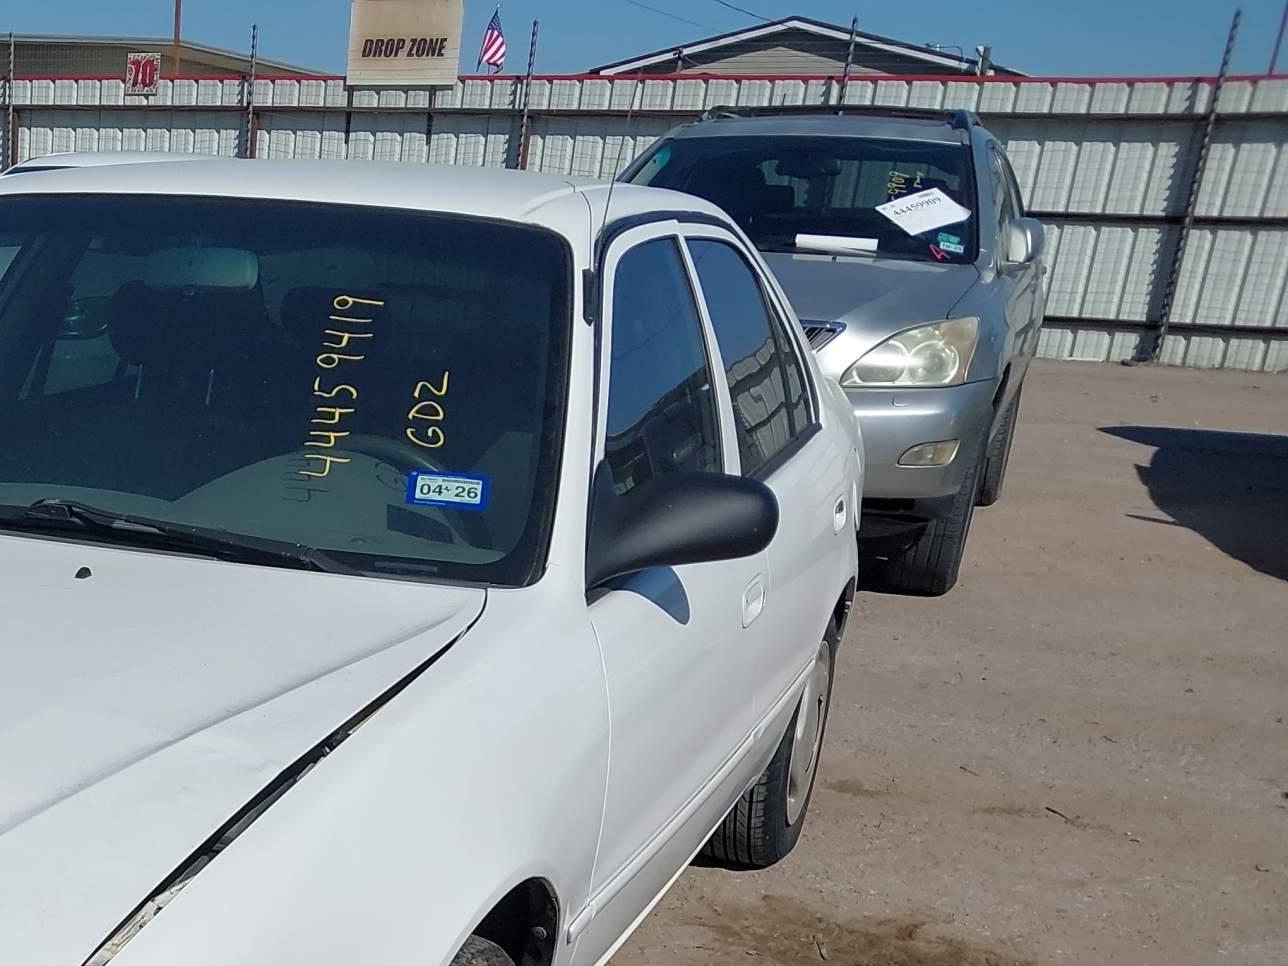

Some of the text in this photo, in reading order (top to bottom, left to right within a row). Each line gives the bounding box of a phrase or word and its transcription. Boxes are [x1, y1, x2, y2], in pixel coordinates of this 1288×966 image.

[361, 37, 448, 58] DROP ZONE
[131, 58, 155, 87] 70
[888, 170, 910, 200] 9909
[298, 295, 384, 477] 44459419
[420, 483, 479, 499] 04 26
